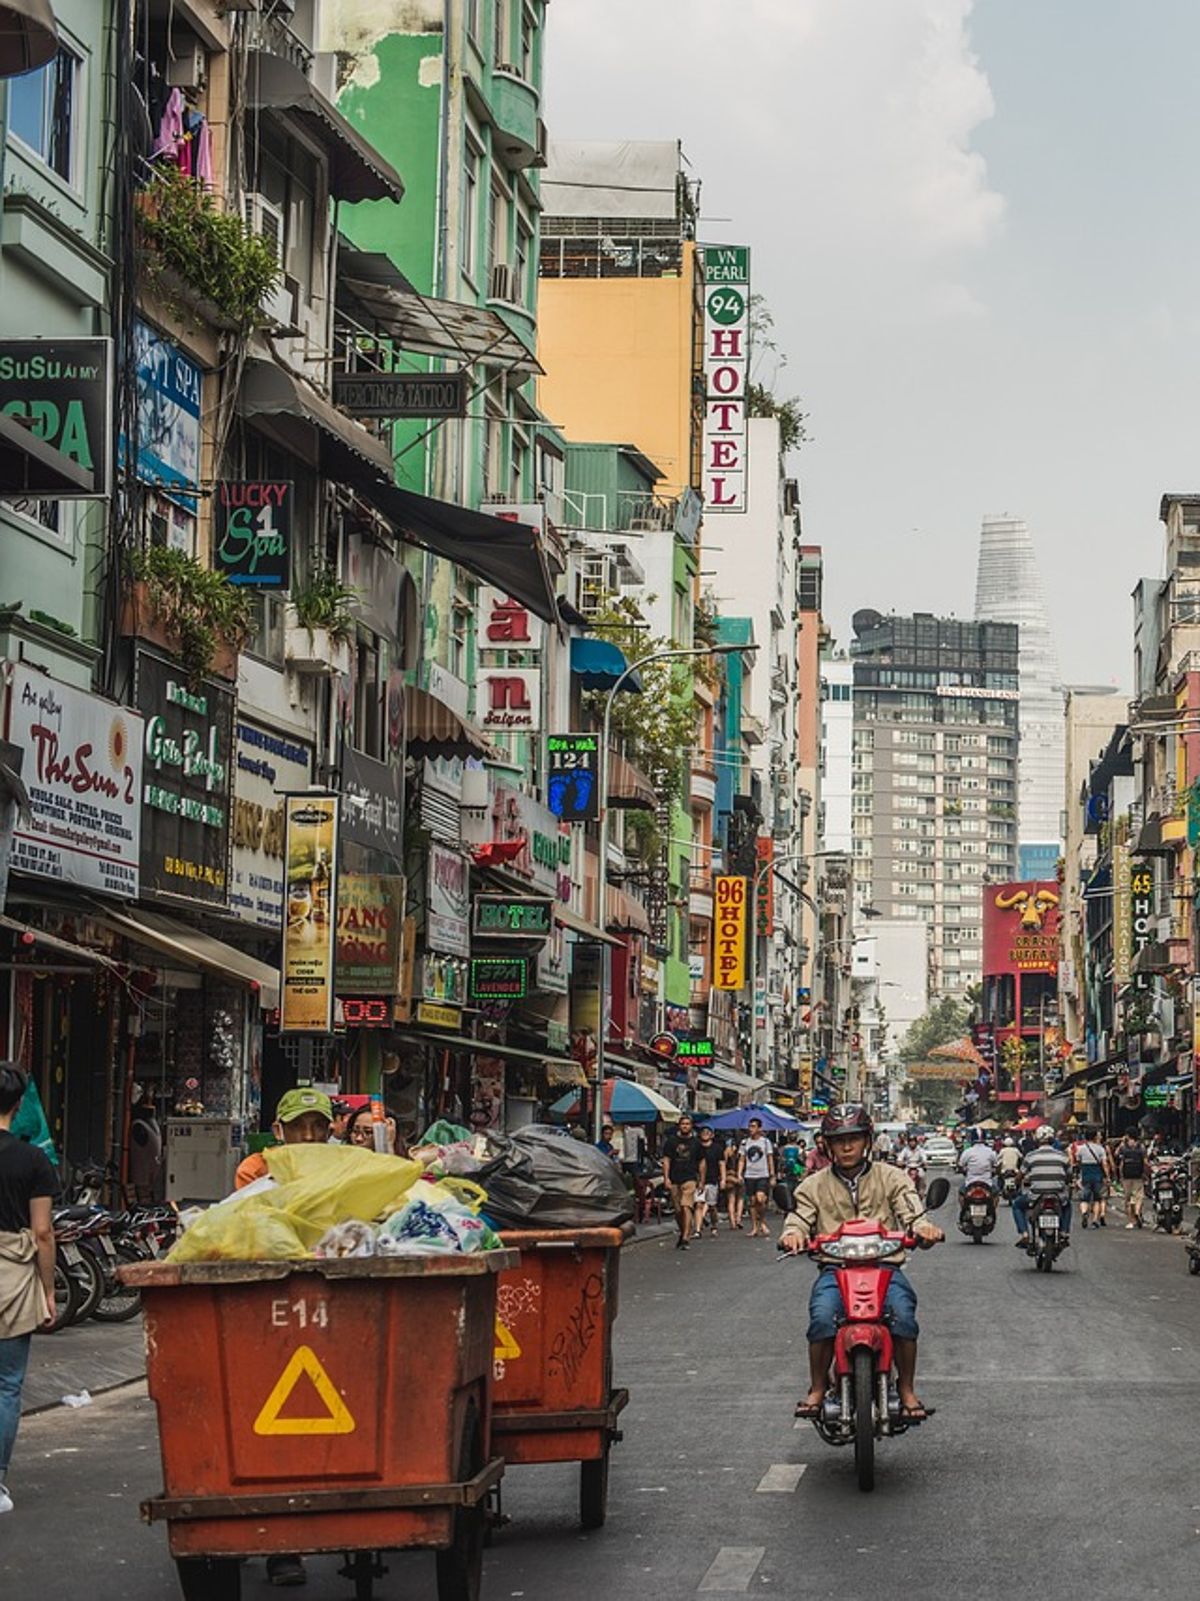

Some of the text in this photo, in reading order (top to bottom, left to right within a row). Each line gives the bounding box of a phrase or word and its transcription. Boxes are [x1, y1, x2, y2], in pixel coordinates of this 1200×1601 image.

[717, 250, 737, 264] VN
[706, 265, 747, 280] PEARL
[711, 296, 741, 316] 94
[406, 384, 454, 408] TATTOO
[710, 330, 743, 505] HOTEL
[220, 484, 287, 506] LUCKY
[219, 508, 286, 573] Spa
[483, 711, 532, 726] Saigon
[552, 752, 590, 769] 124
[717, 880, 743, 904] 96
[1133, 875, 1151, 895] 65
[480, 903, 549, 929] HOTEL
[719, 907, 738, 987] HOTEL
[1135, 900, 1150, 988] HOTL
[271, 1299, 330, 1329] E14
